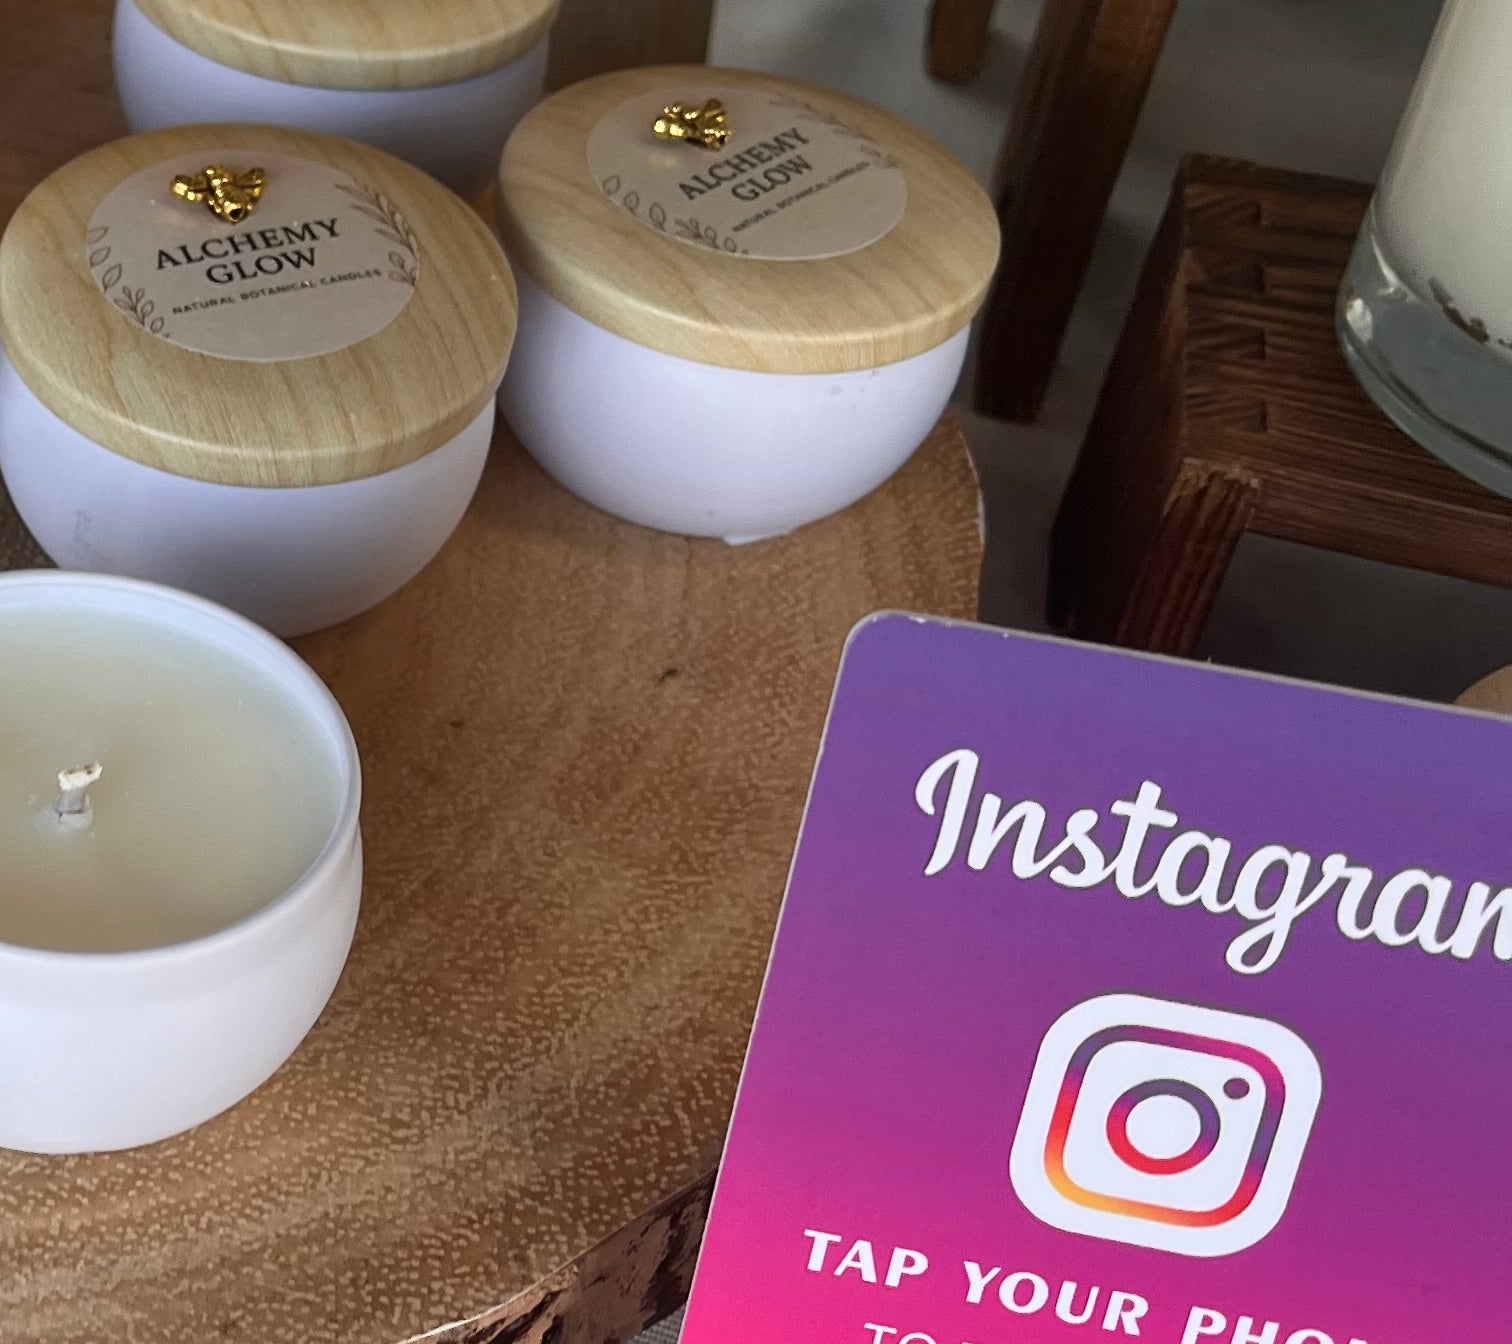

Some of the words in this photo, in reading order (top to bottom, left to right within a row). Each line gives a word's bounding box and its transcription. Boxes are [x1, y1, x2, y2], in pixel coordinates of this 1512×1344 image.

[678, 126, 810, 201] ALCHEMY
[730, 154, 814, 202] GLOW
[155, 217, 342, 271] ALCHEMY
[205, 246, 318, 286] GLOW
[172, 295, 236, 315] NATURAL
[239, 279, 318, 302] BOTANICAL
[320, 268, 382, 287] CANDLES
[803, 1228, 930, 1289] TAP
[962, 1259, 1151, 1338] YOUR
